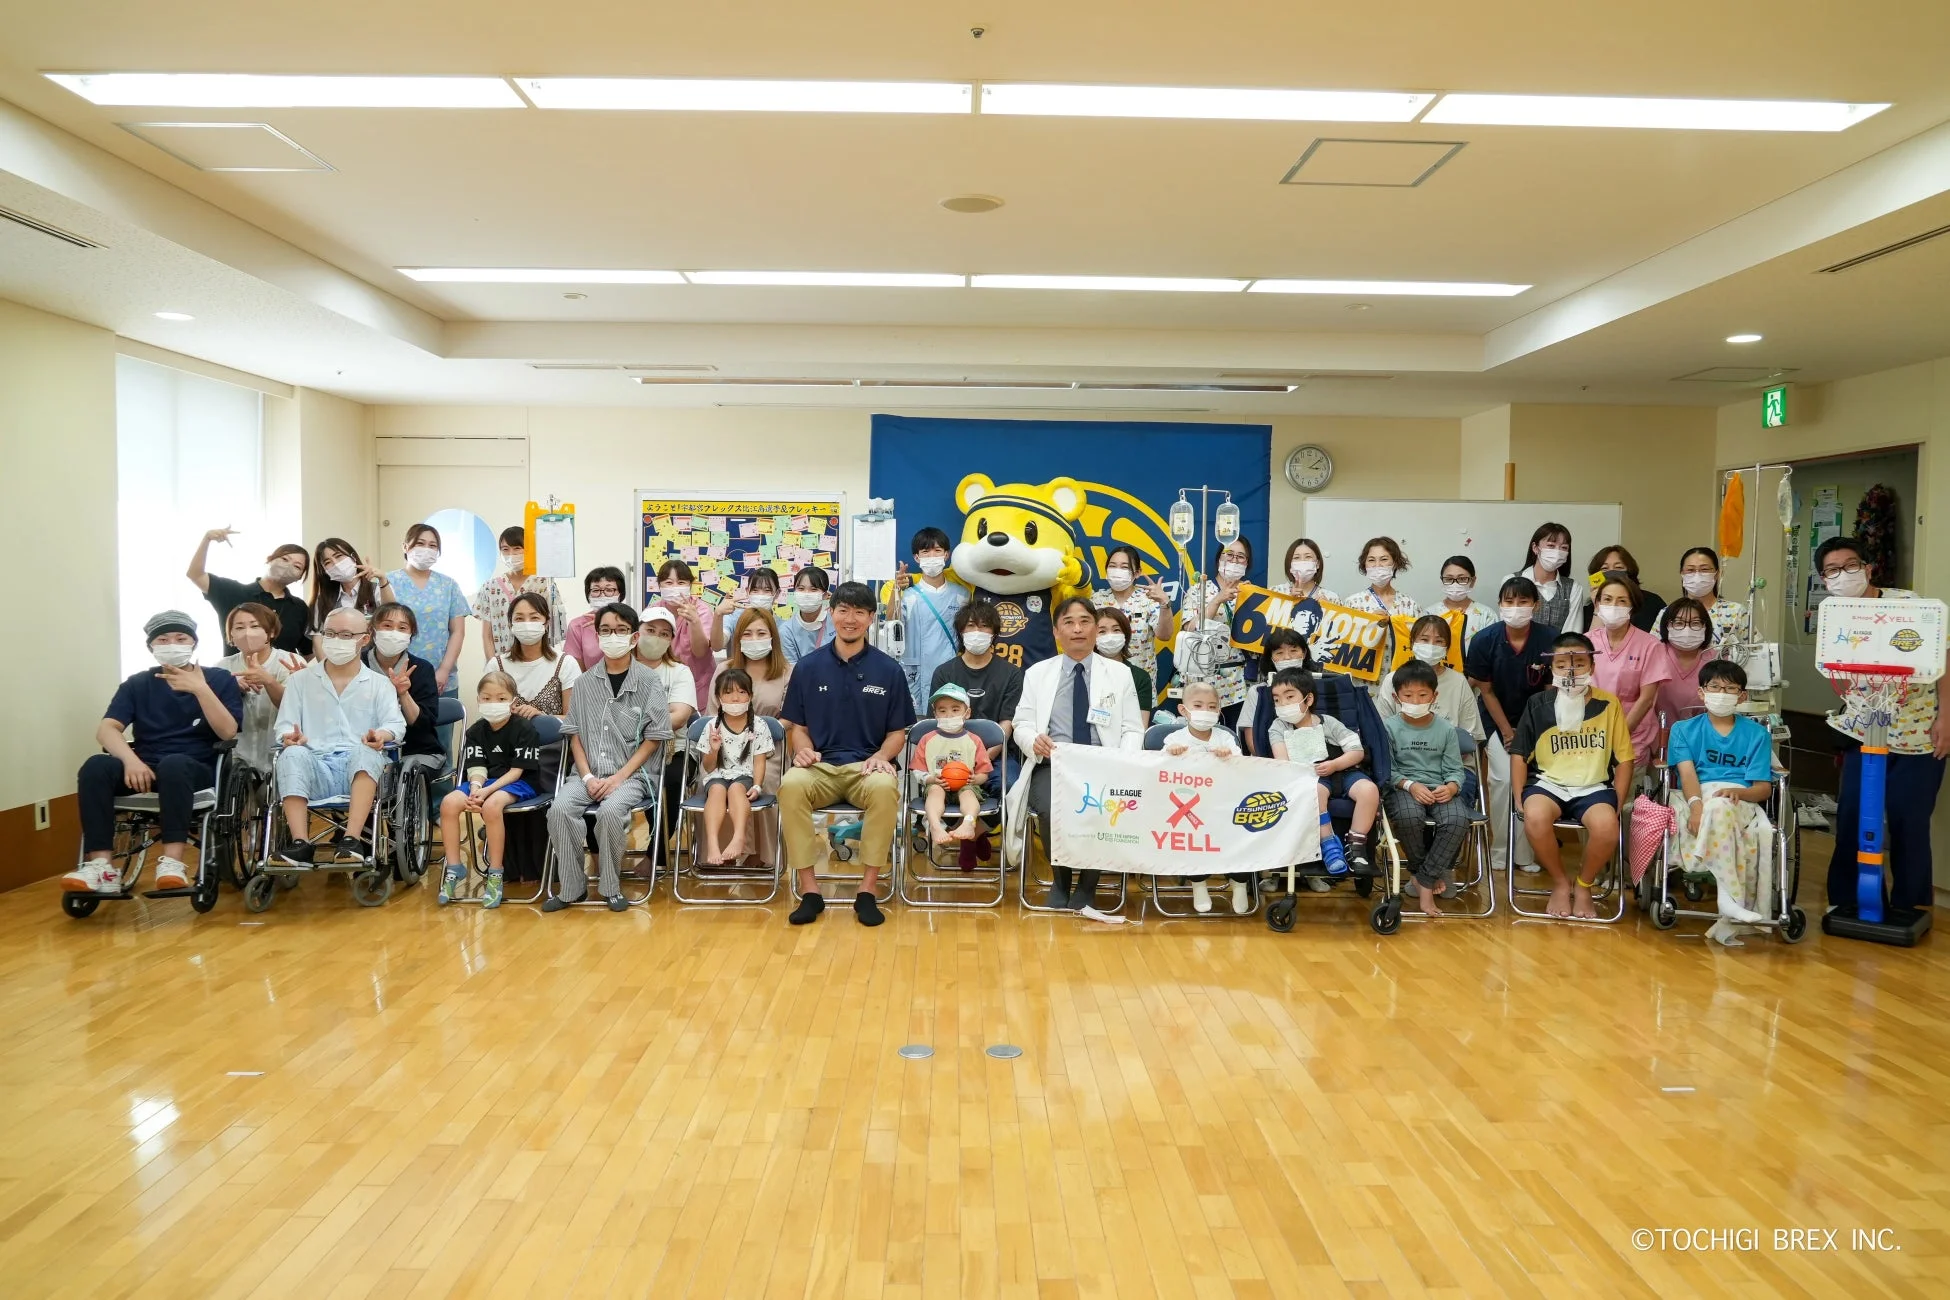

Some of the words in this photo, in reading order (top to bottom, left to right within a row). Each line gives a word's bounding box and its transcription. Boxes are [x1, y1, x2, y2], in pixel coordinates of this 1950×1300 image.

[1231, 592, 1271, 645] 6
[862, 686, 887, 696] BREX
[1551, 730, 1605, 755] BRAVES
[1159, 770, 1214, 789] B.Hope
[1110, 788, 1143, 798] B.LEAGUE
[1150, 830, 1221, 852] YELL
